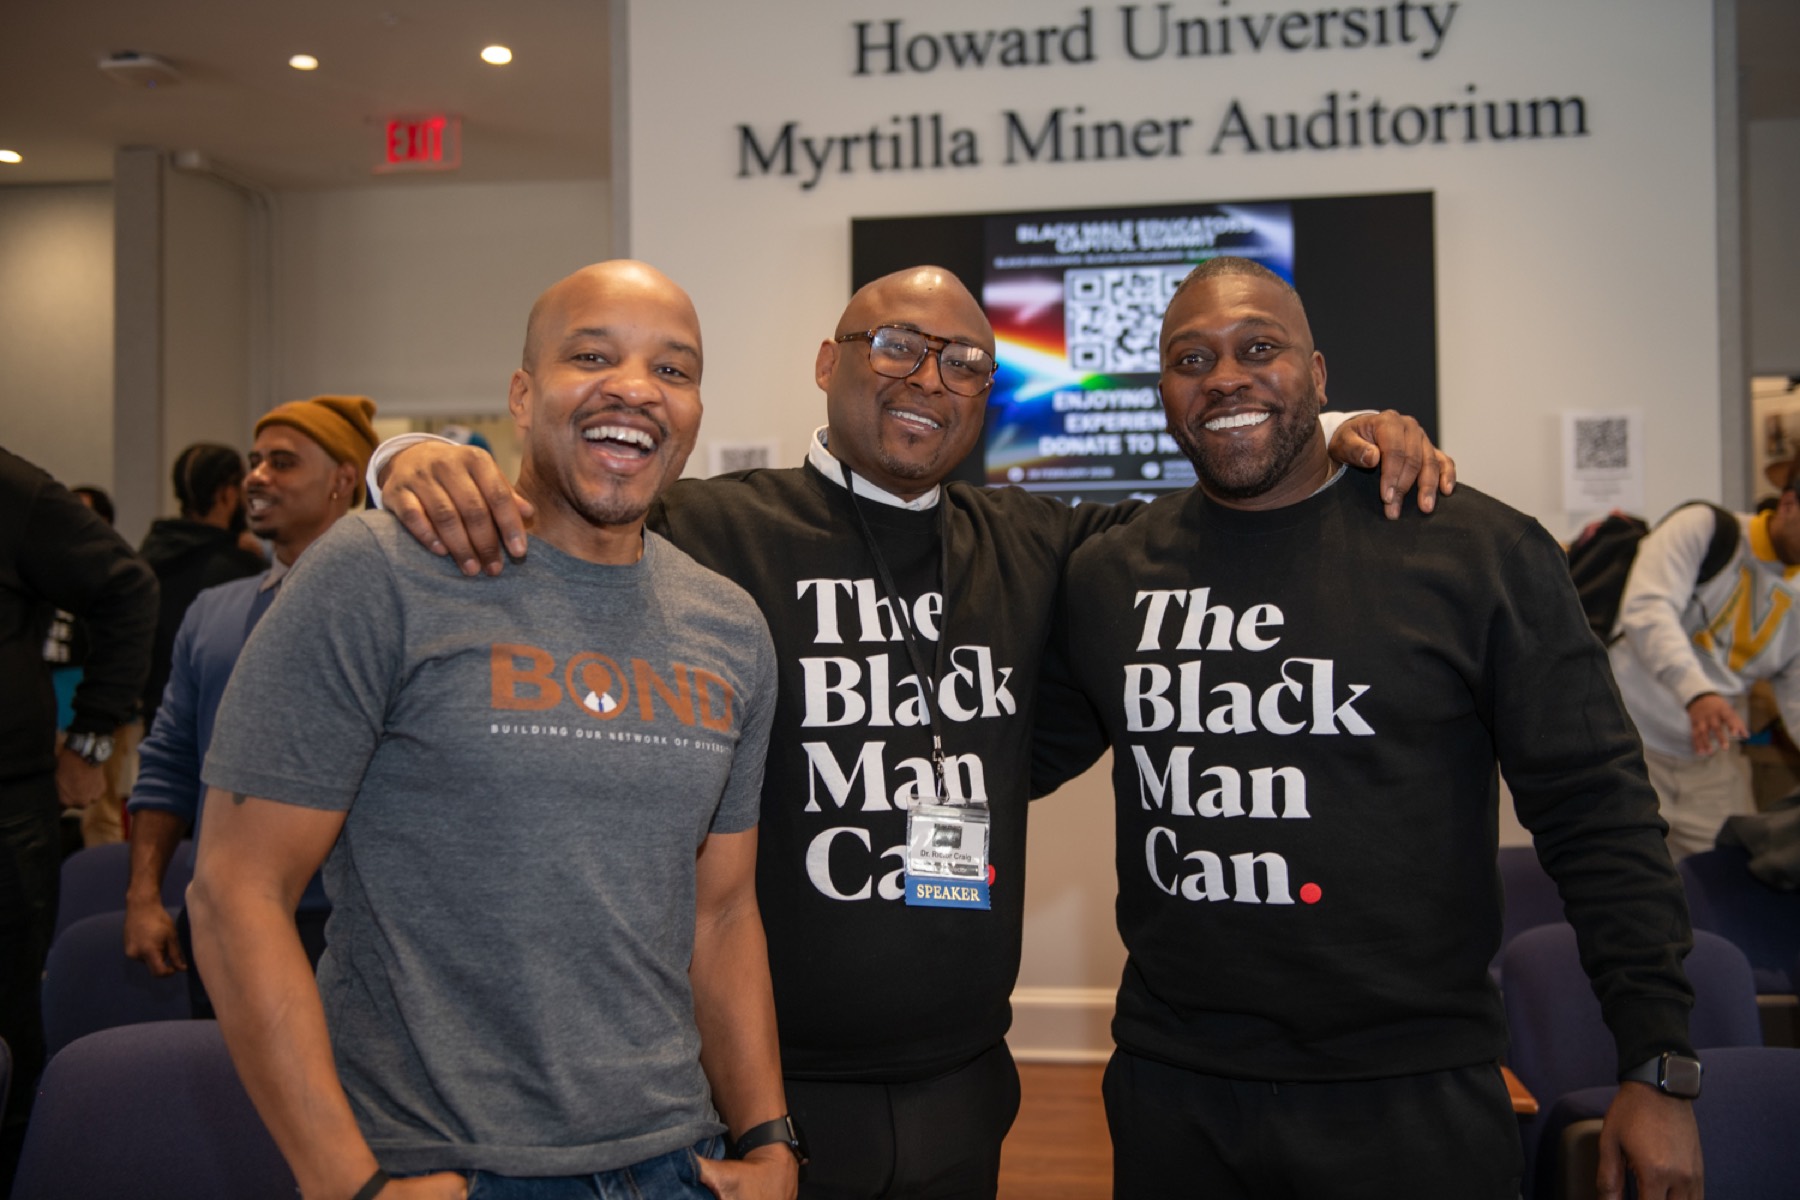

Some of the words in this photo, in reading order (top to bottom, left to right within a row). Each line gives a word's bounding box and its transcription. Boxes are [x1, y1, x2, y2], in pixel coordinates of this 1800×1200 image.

[852, 8, 1097, 76] Howard
[1118, 0, 1459, 58] University
[386, 117, 446, 163] EXIT
[736, 111, 980, 190] Myrtilla
[1002, 105, 1192, 164] Miner
[1209, 83, 1591, 156] Auditorium
[1053, 388, 1156, 411] ENJOYING
[1064, 412, 1168, 434] EXPERIEN
[1038, 434, 1122, 457] DONATE
[1125, 433, 1155, 454] TO
[797, 578, 943, 643] The
[1134, 587, 1285, 652] The
[490, 643, 735, 733] BOND
[799, 645, 1016, 727] Black
[1123, 657, 1376, 736] Black
[490, 724, 568, 736] BUILDING
[576, 728, 602, 740] OUR
[610, 732, 668, 745] NETWORK
[674, 738, 689, 748] OF
[802, 741, 987, 812] Man
[1131, 745, 1312, 818] Man
[917, 883, 981, 902] SPEAKER
[1145, 826, 1322, 905] Can.
